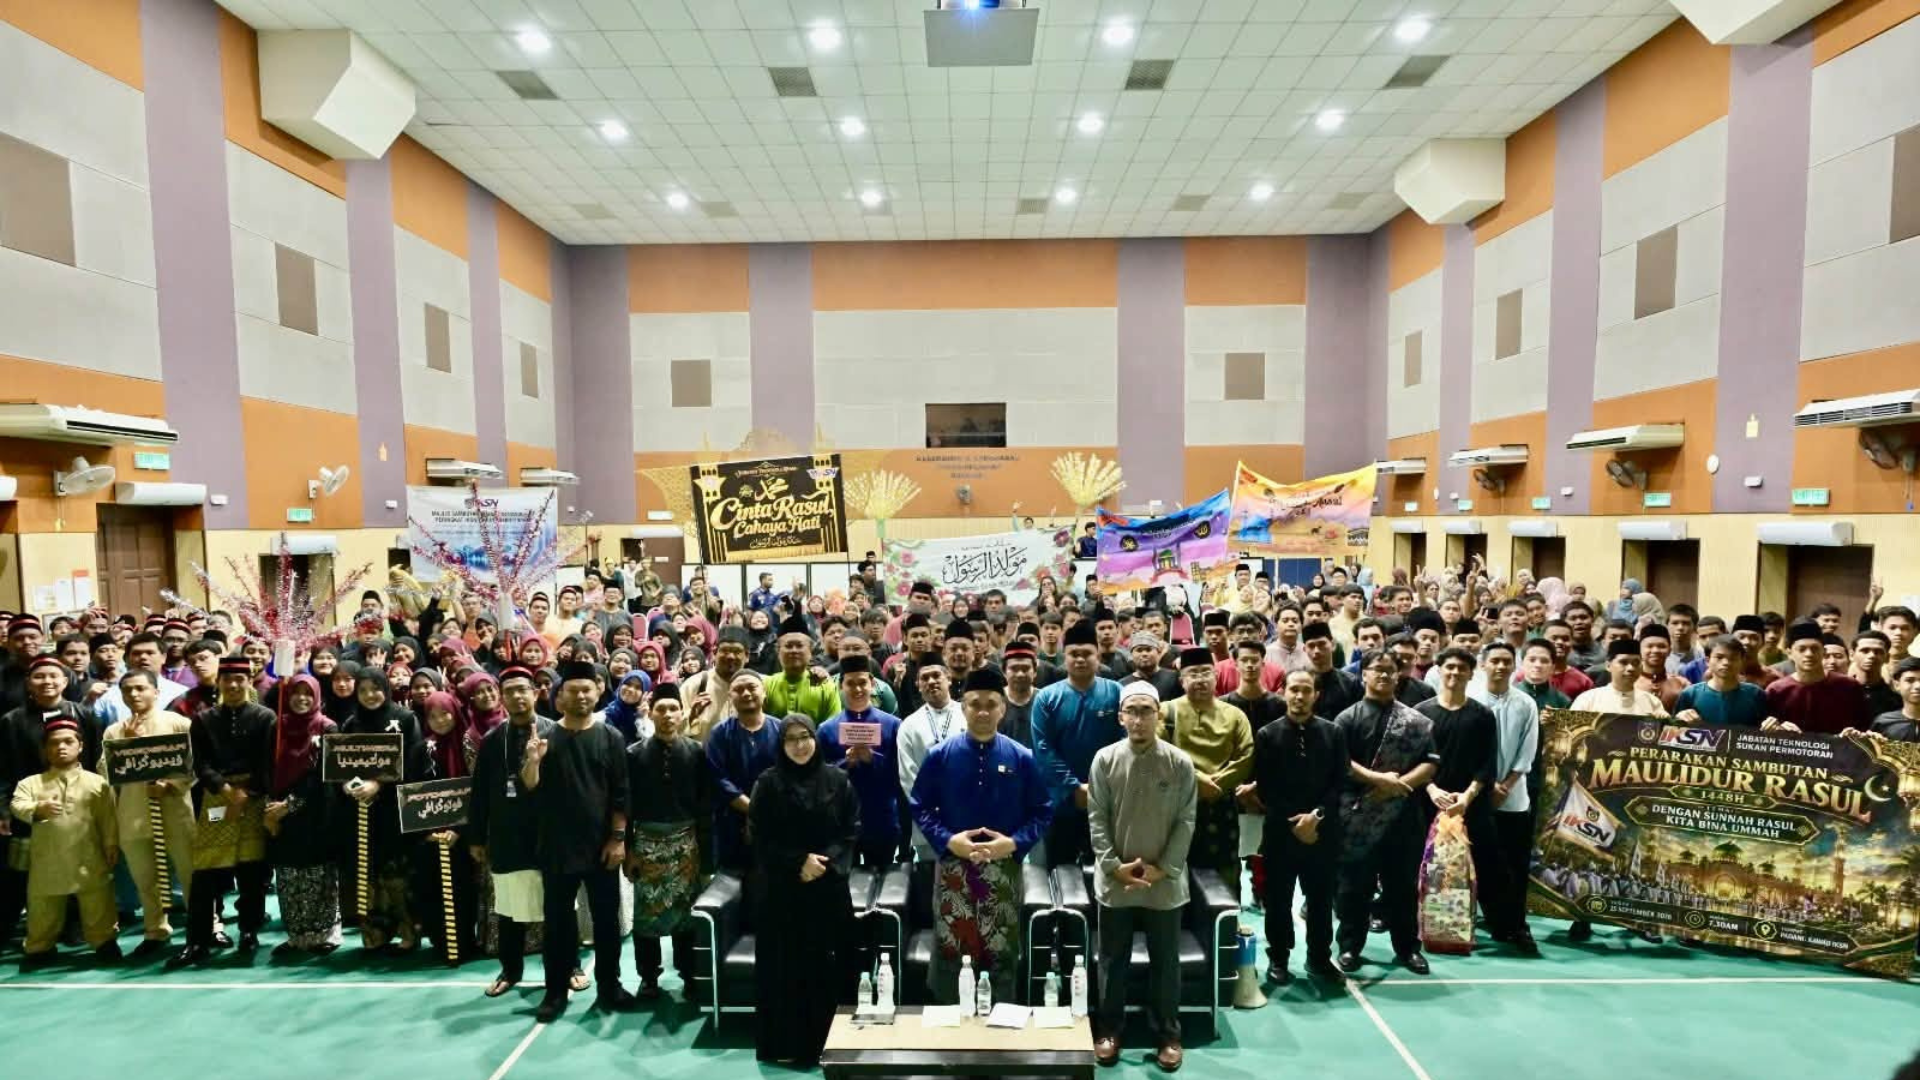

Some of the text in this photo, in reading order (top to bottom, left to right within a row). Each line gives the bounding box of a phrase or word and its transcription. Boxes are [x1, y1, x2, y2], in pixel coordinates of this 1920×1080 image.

[709, 497, 773, 530] Cinta
[733, 515, 821, 540] Cahaya Hati
[1659, 726, 1727, 748] IKSN
[1737, 734, 1830, 750] JABATAN TEKNOLOGI
[1735, 742, 1834, 759] SUKAN PERMOTORAN
[1630, 746, 1828, 780] PERARAKAN SAMBUTAN
[1587, 757, 1872, 823] MAULIDUR RASUL
[1701, 790, 1745, 804] 1448H
[1563, 814, 1611, 842] IKSN
[1652, 804, 1796, 831] DENGAN SUNNAH RASUL
[1665, 815, 1780, 838] KITA BINA UMMAH
[1618, 907, 1655, 917] SEPTEMBER
